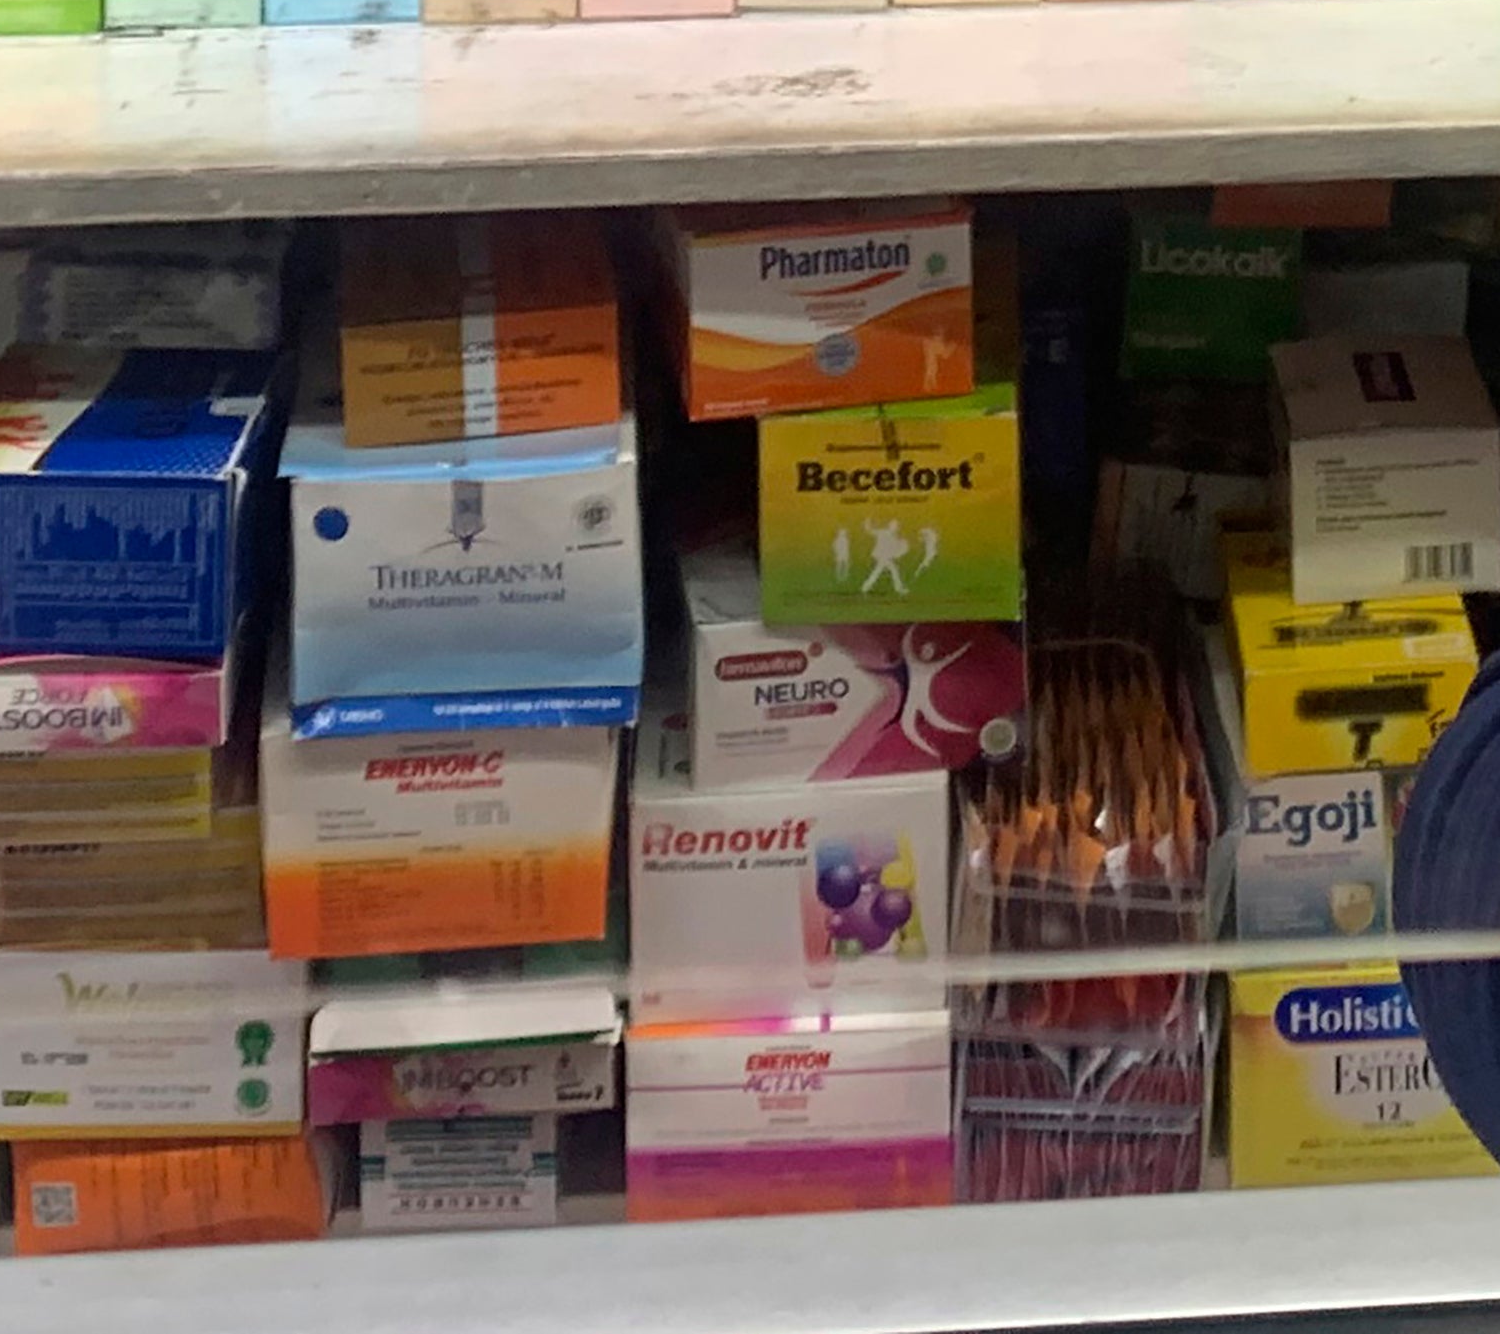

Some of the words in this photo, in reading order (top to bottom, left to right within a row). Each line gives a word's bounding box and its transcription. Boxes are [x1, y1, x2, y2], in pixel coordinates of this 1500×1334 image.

[760, 237, 910, 280] Pharmaton
[796, 459, 973, 495] Becefort
[754, 674, 850, 708] NEURO
[641, 817, 812, 857] Renovit
[1245, 792, 1376, 844] Egoji
